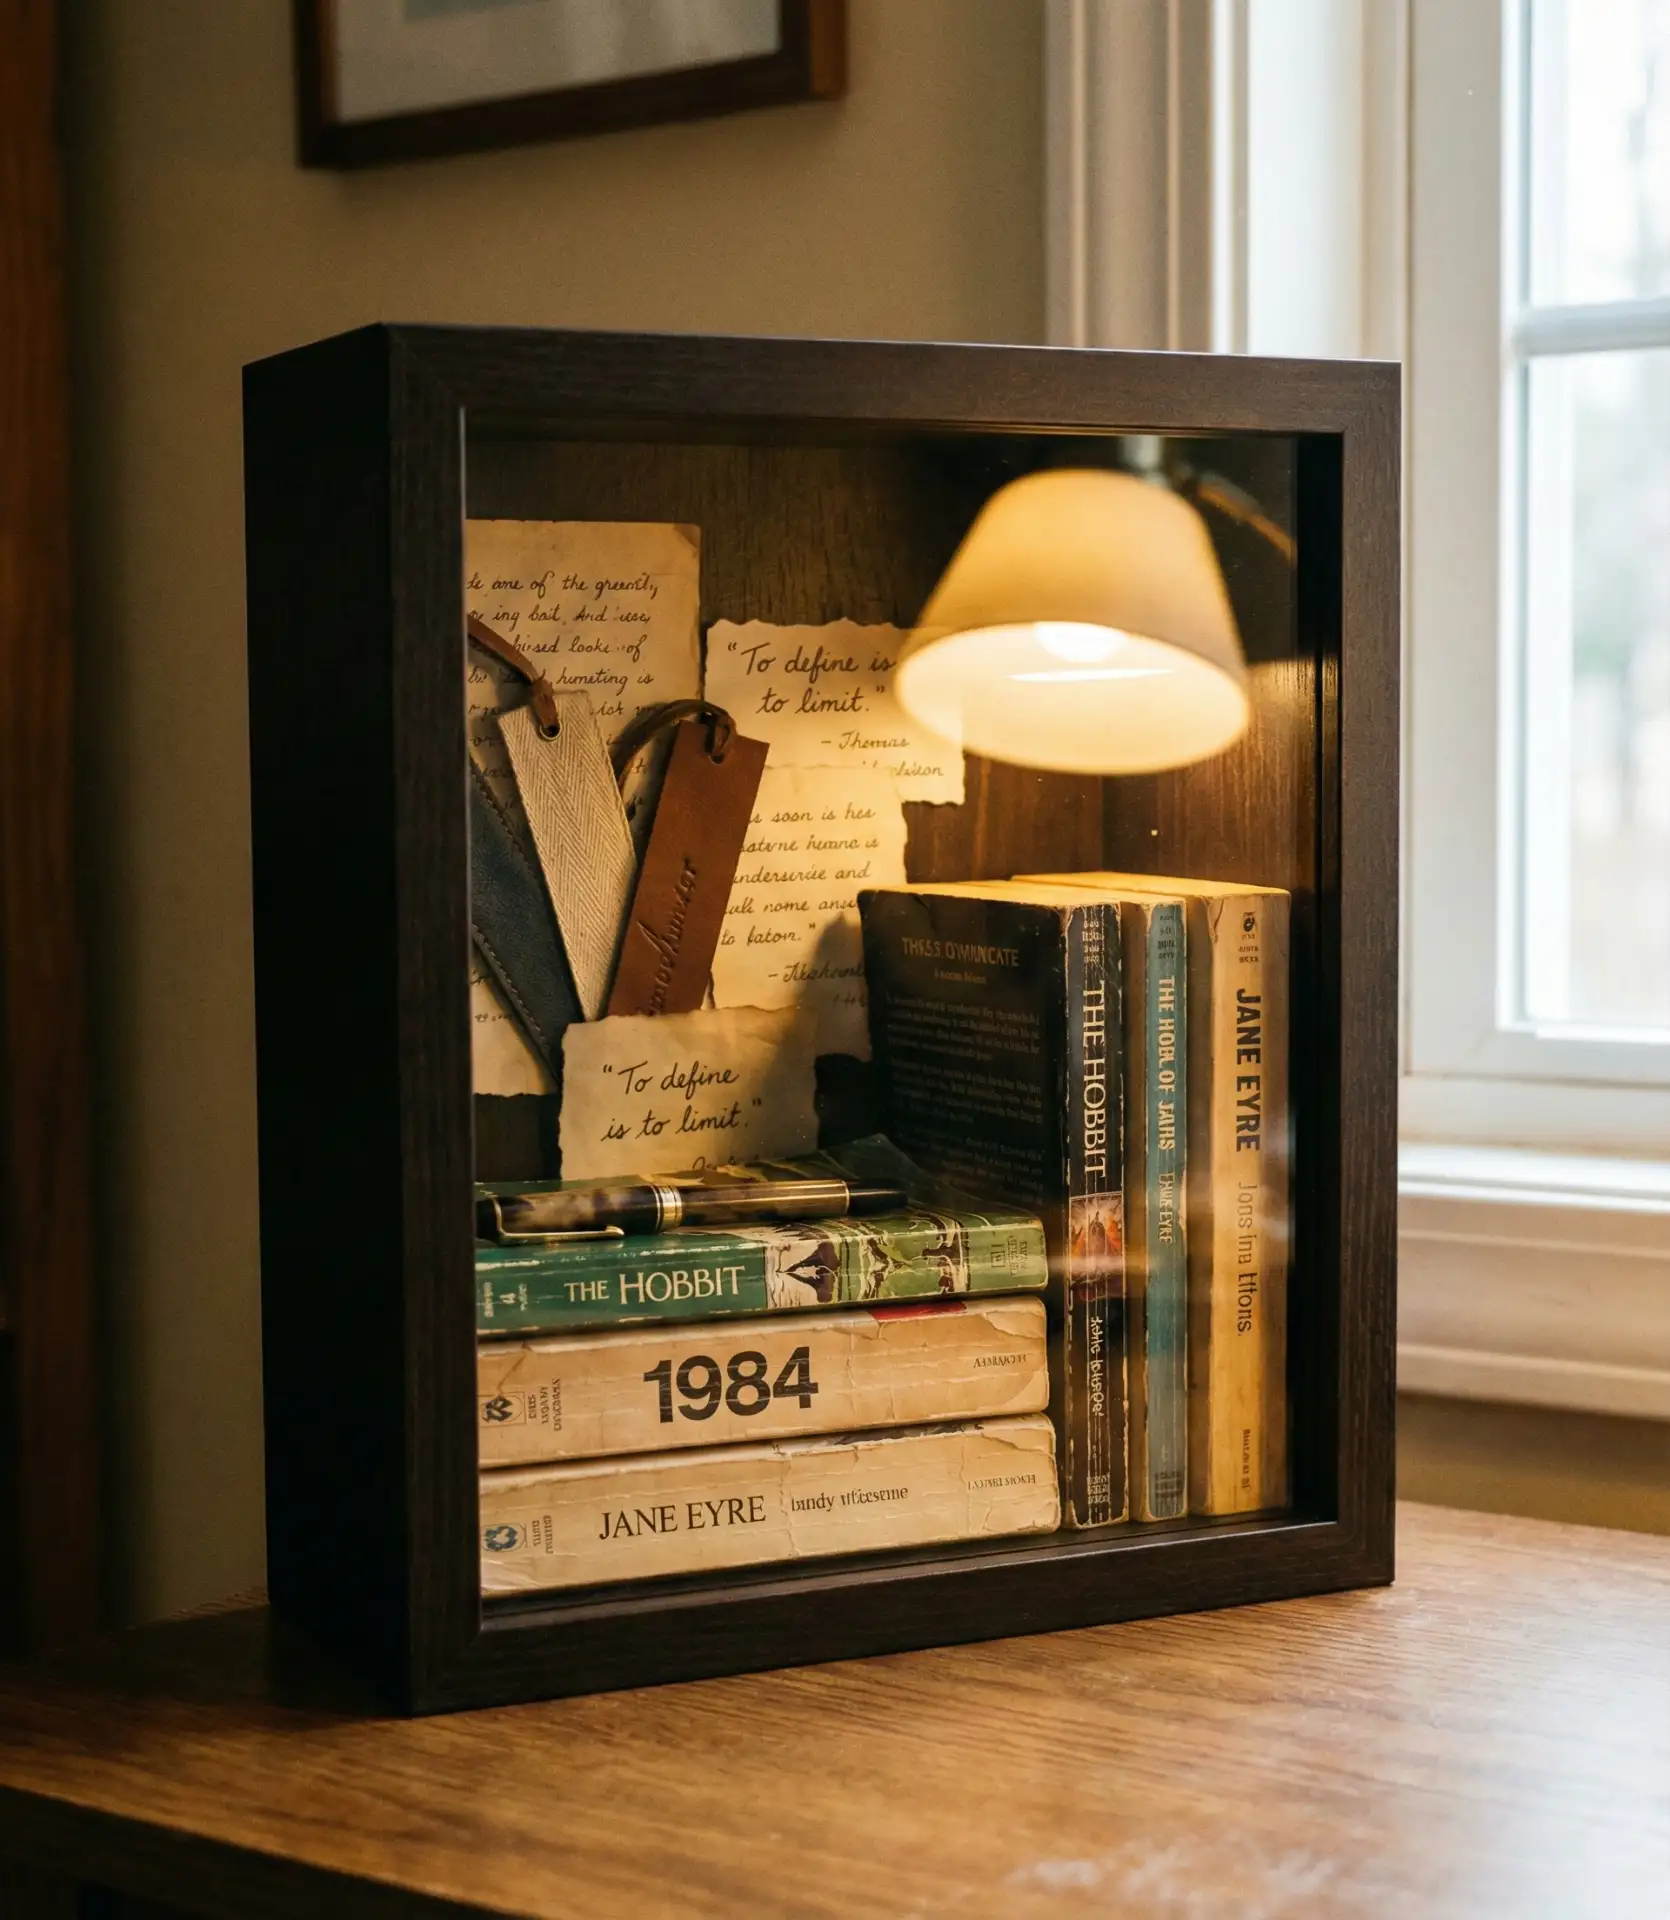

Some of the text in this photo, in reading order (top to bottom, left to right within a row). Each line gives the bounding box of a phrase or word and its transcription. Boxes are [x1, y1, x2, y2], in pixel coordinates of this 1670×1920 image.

[530, 570, 556, 600] of
[560, 573, 588, 591] the
[626, 634, 648, 663] of
[784, 645, 860, 685] define
[868, 650, 897, 673] is
[755, 687, 790, 714] to
[834, 860, 871, 880] and
[1083, 979, 1106, 1048] THE
[1158, 975, 1176, 1013] THE
[1236, 988, 1261, 1066] JANE
[660, 1060, 741, 1101] define
[600, 1117, 632, 1143] is
[634, 1109, 672, 1140] to
[1083, 1057, 1107, 1178] HOBBIT
[1236, 1075, 1261, 1153] EYRE
[563, 1280, 611, 1303] THE
[618, 1265, 746, 1305] HOBBIT
[643, 1346, 819, 1424] 1984
[599, 1495, 768, 1541] JANE EYRE
